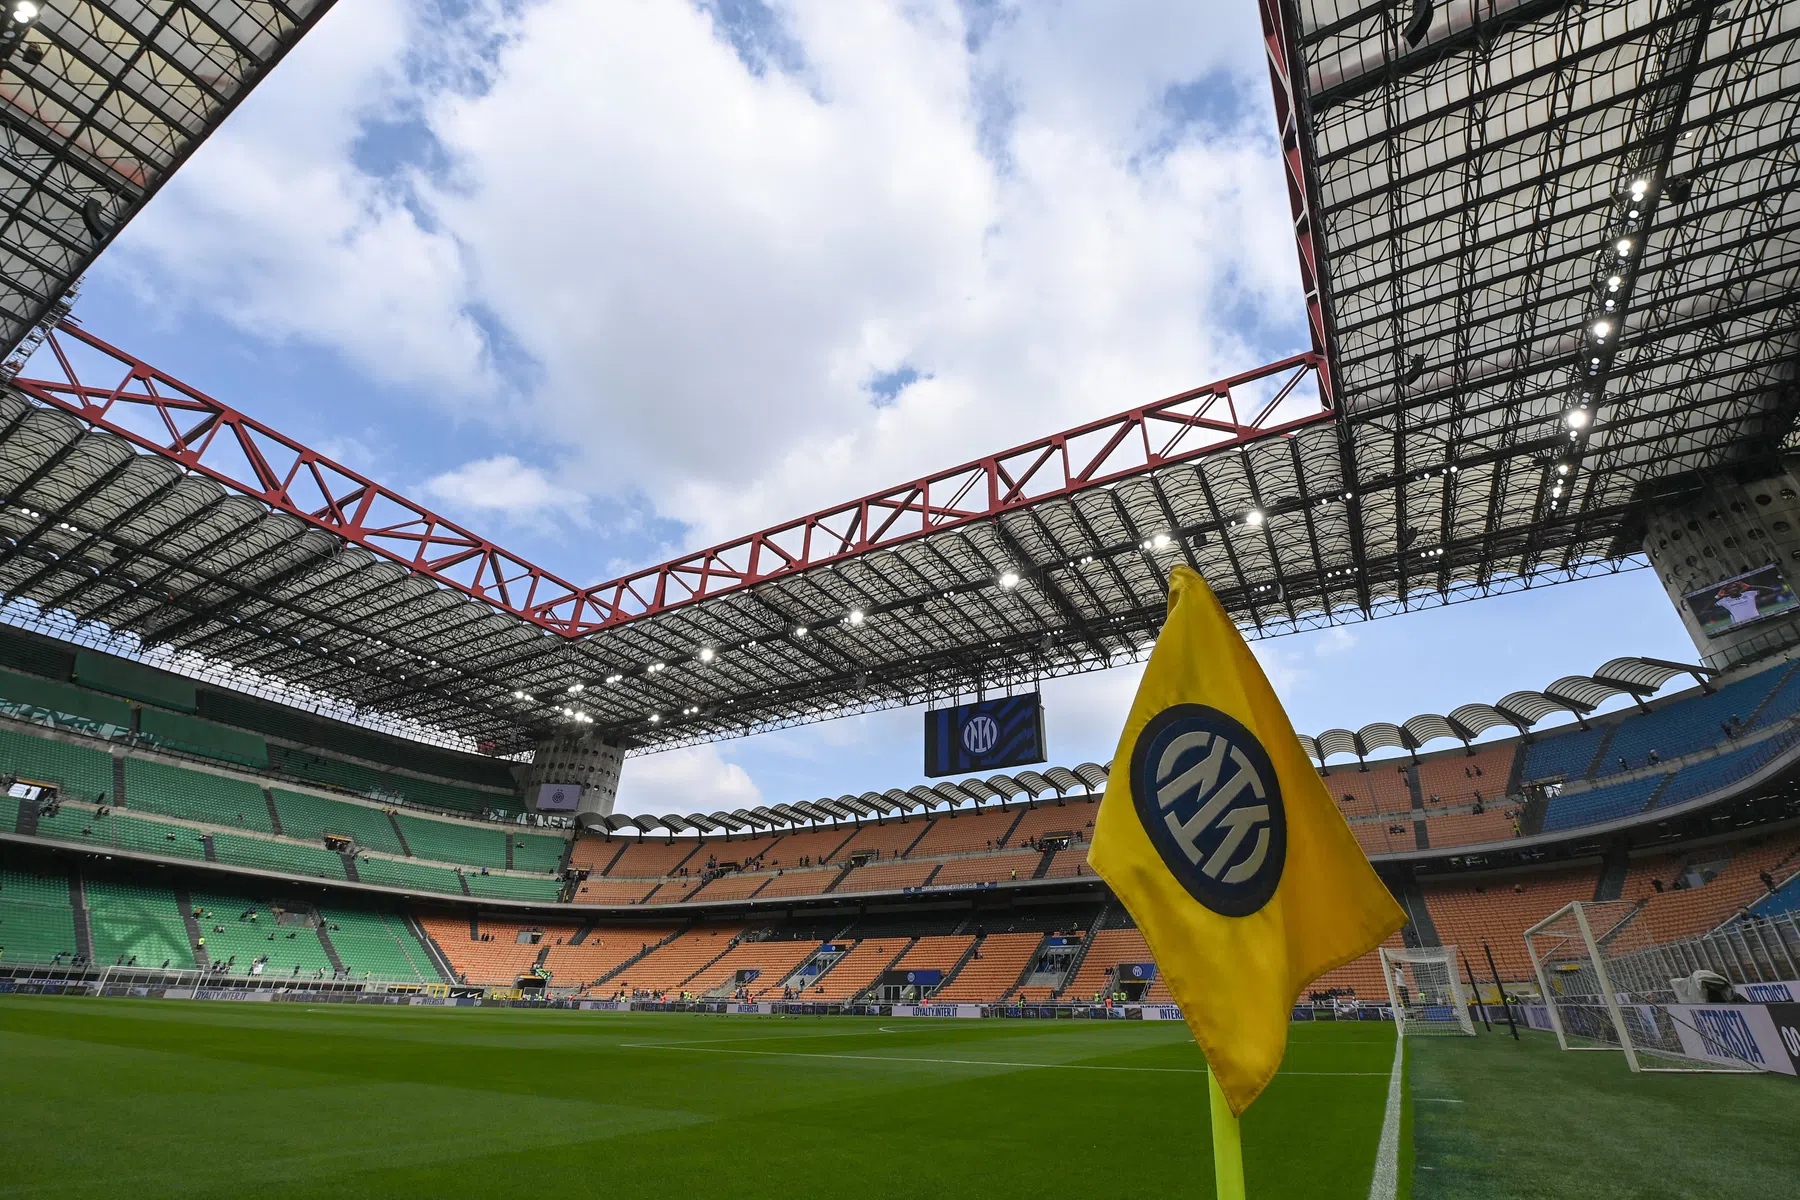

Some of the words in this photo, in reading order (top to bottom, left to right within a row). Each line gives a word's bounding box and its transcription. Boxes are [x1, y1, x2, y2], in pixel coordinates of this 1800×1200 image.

[196, 990, 248, 1001] OYALTY.INTER.IT
[737, 1004, 759, 1013] INTERISTA
[912, 1007, 957, 1017] LOYALTY.INTER.IT
[1689, 1009, 1766, 1065] INTERISTA
